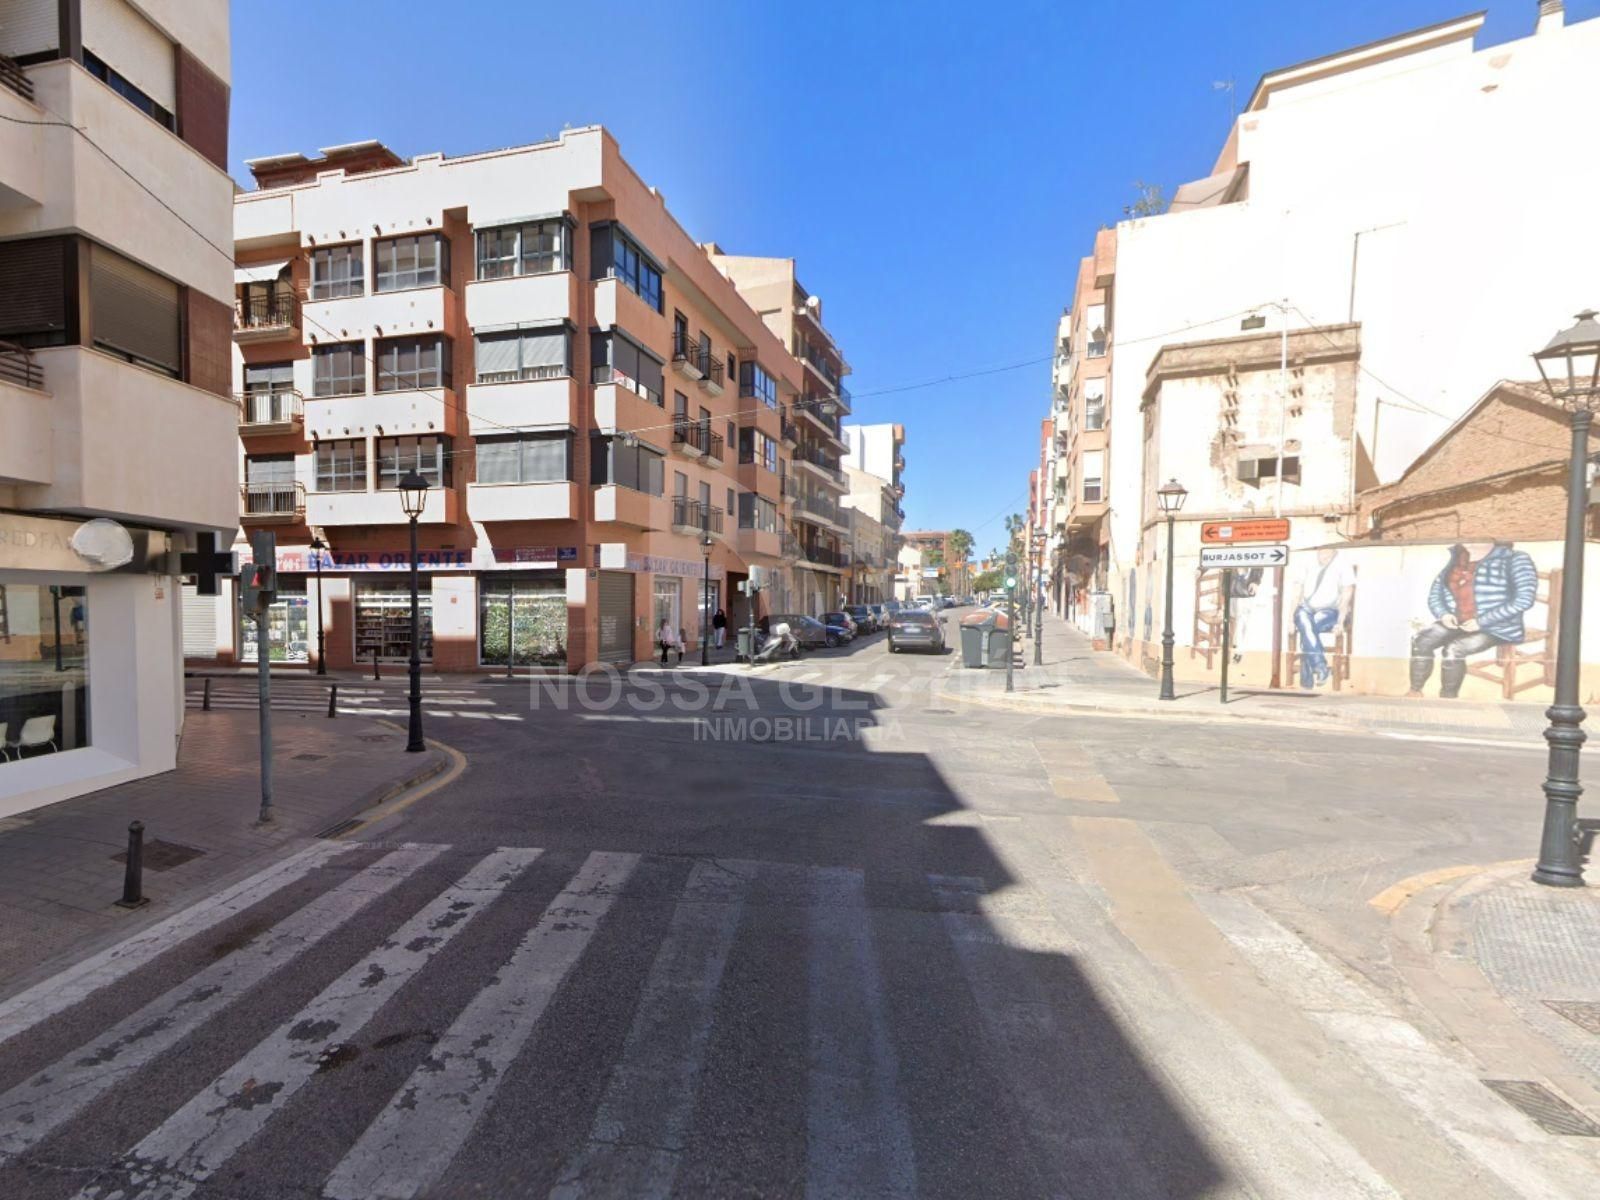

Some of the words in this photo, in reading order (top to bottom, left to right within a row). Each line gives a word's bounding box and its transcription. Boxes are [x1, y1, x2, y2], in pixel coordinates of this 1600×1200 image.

[308, 551, 369, 569] BAZAR
[379, 551, 466, 568] ORENTE
[1203, 552, 1266, 561] BURJASSOT
